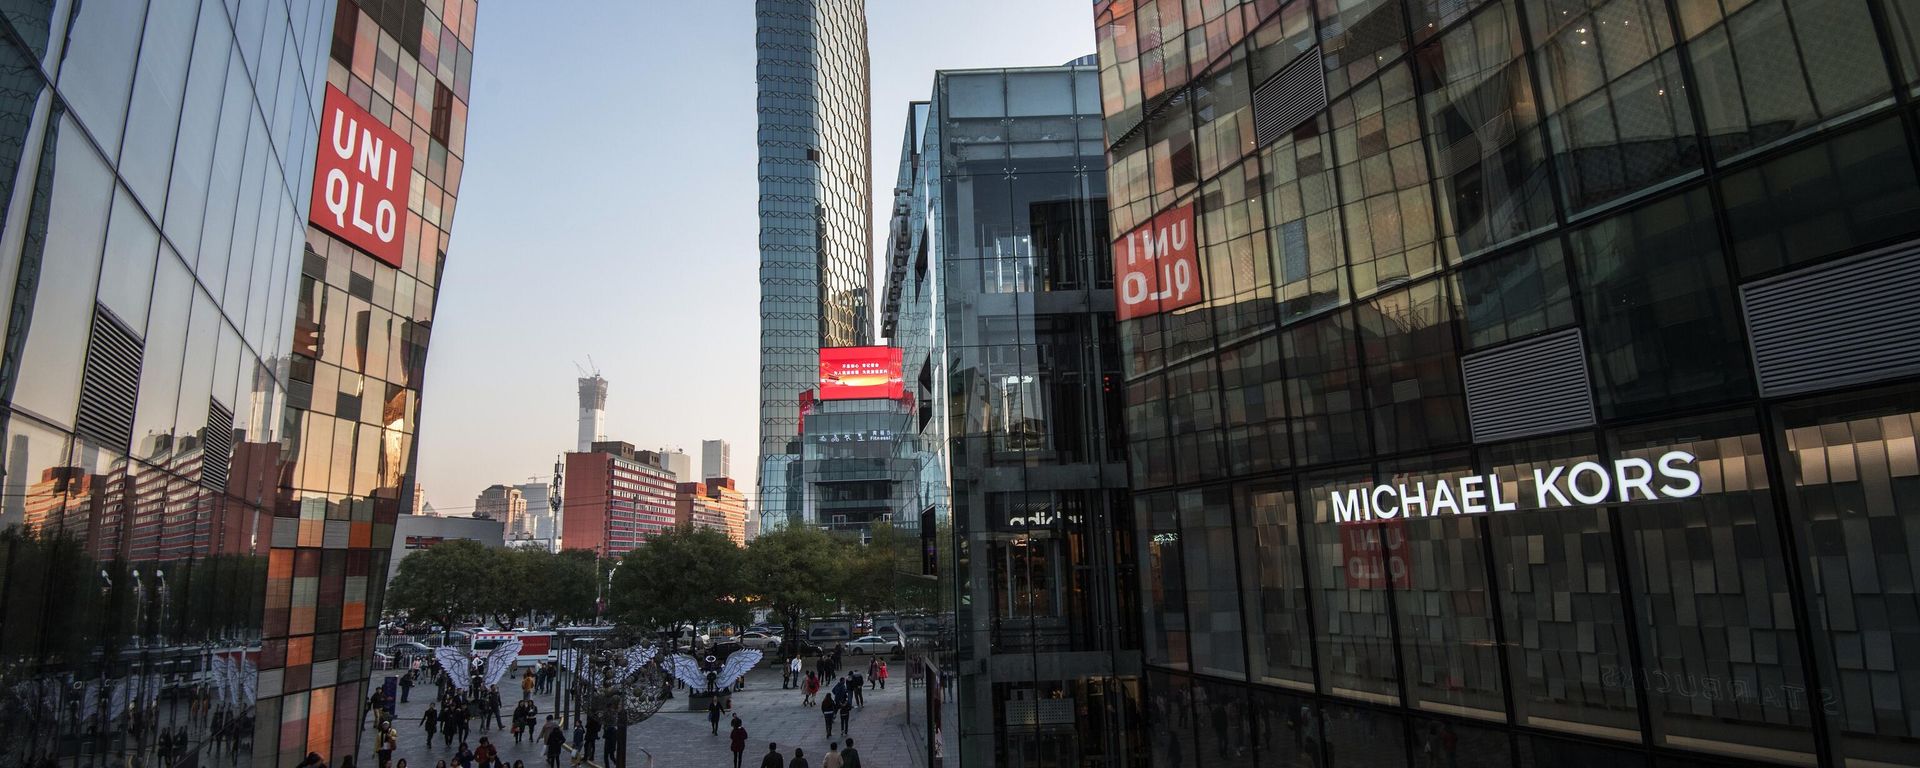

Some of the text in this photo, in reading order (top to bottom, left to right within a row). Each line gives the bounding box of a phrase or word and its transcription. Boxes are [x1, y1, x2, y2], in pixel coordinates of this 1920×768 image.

[333, 108, 397, 191] UNI
[325, 168, 396, 243] QLO
[1331, 450, 1701, 523] MICHAEL KORS
